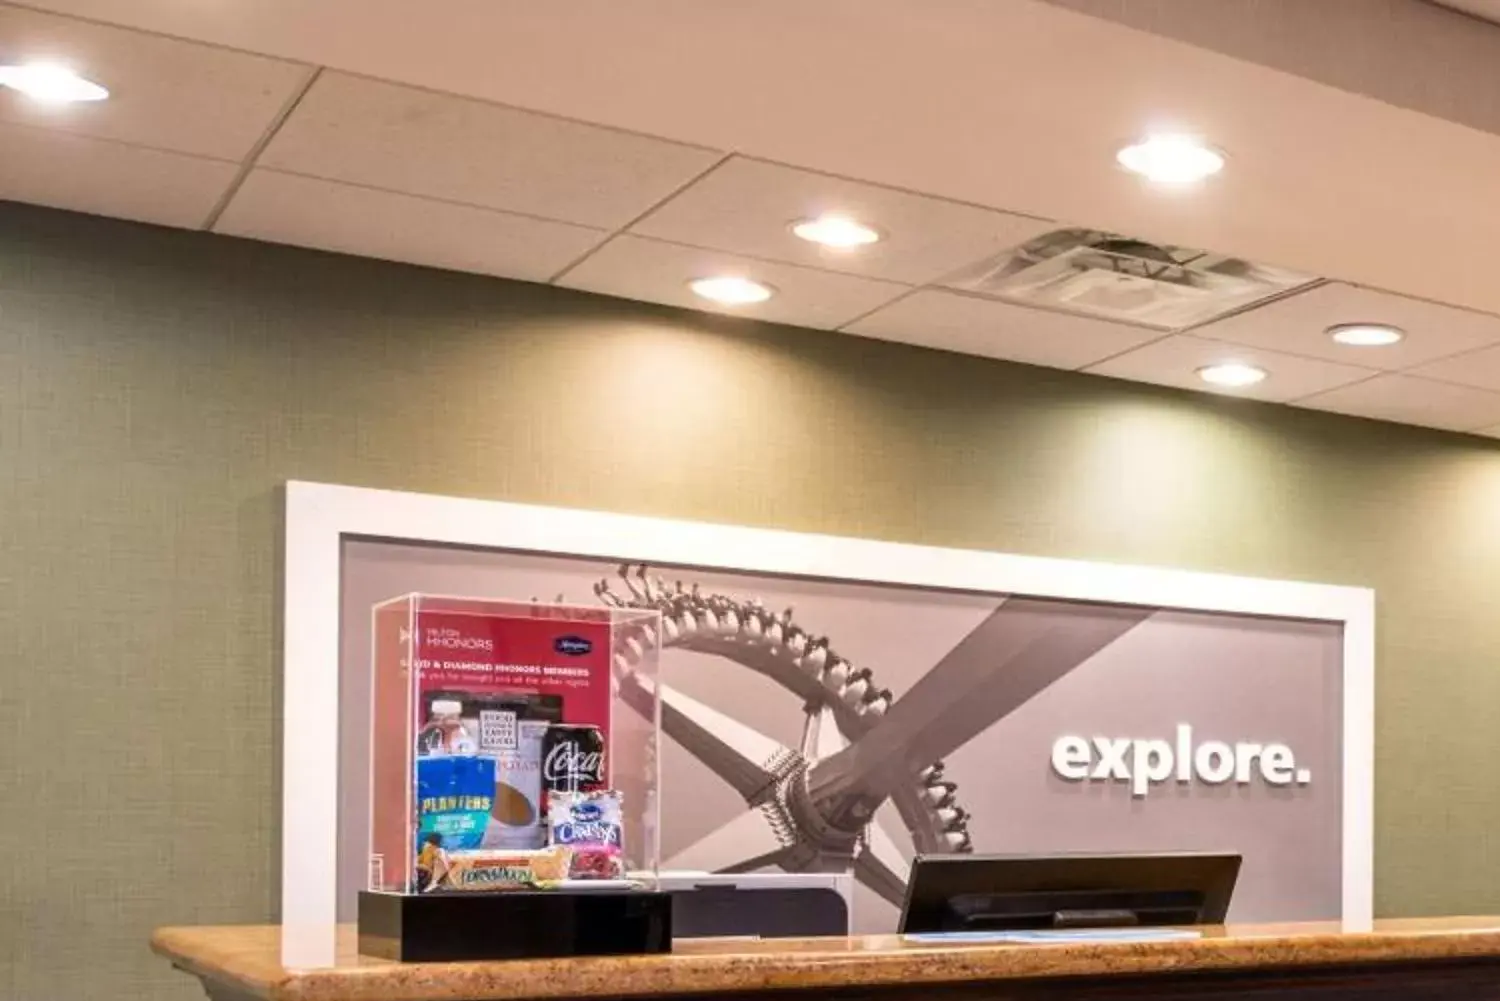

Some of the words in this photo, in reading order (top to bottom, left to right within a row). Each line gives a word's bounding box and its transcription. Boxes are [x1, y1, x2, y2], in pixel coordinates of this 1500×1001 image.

[426, 636, 493, 652] HHONORS
[444, 661, 493, 671] DIAMOND
[543, 666, 590, 677] MEMBERS
[1051, 721, 1312, 799] explore.
